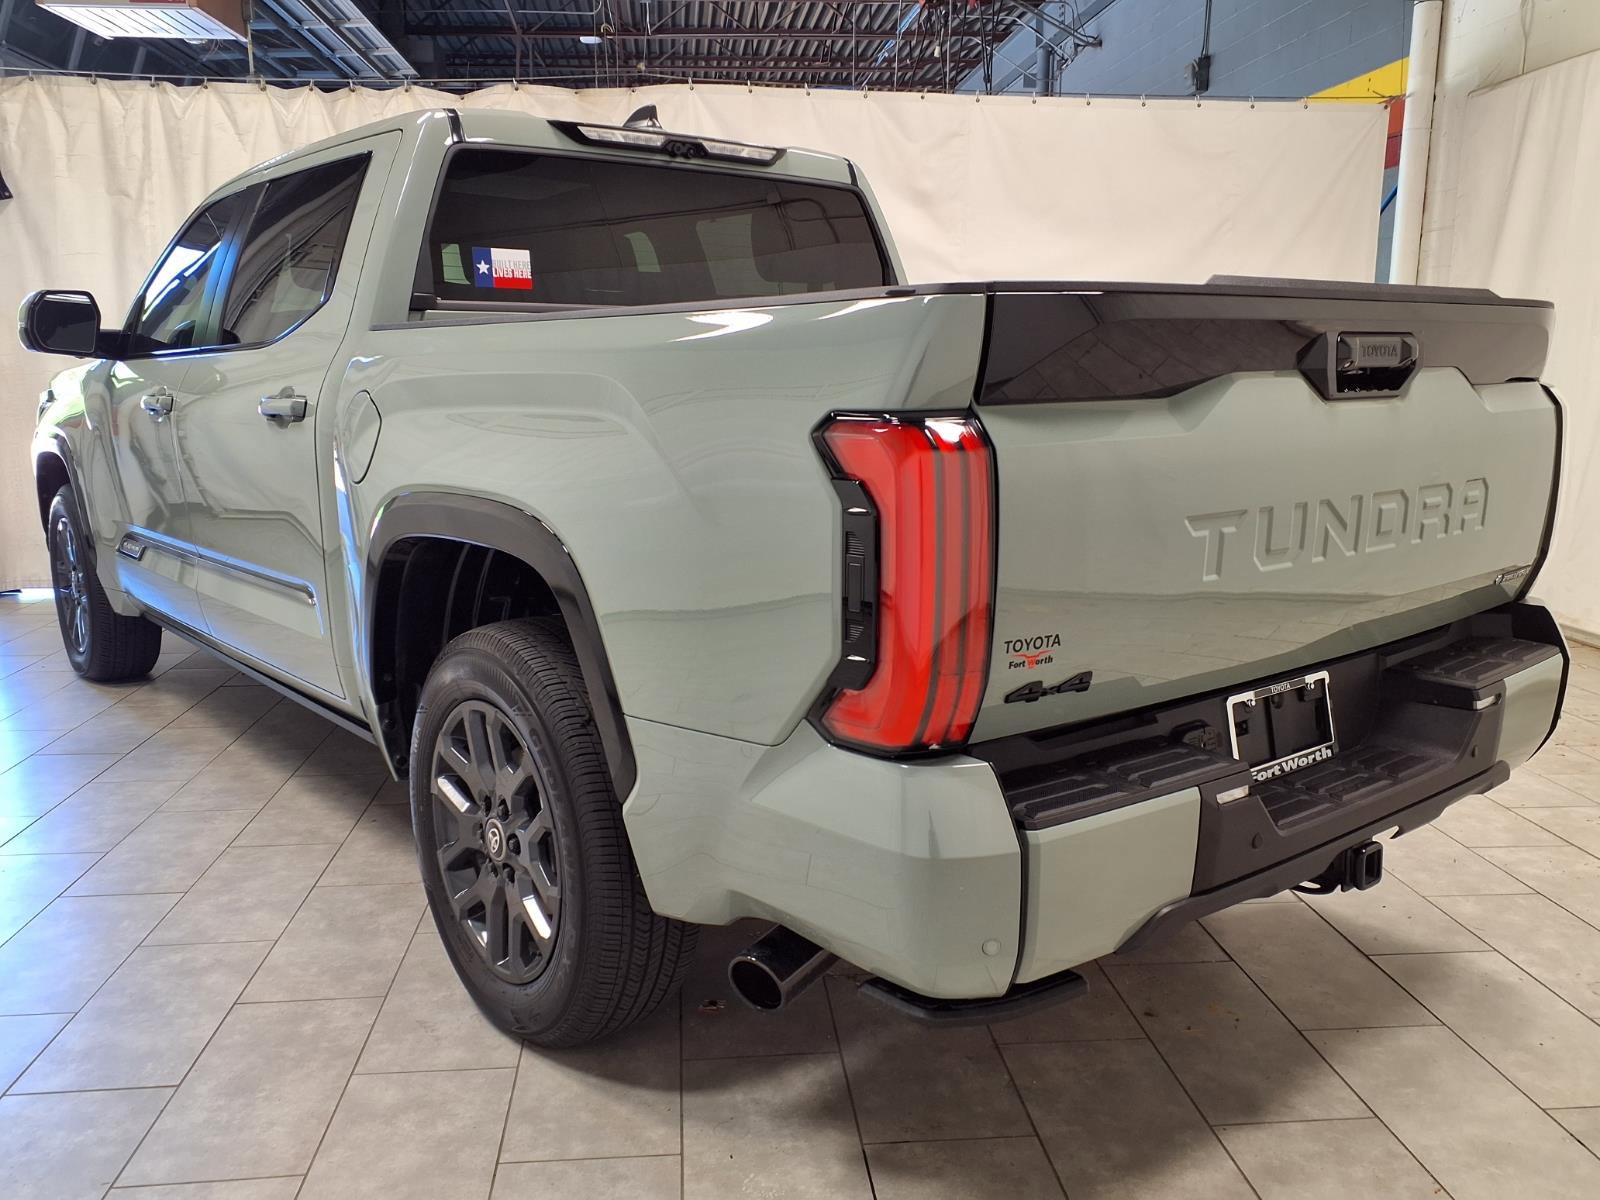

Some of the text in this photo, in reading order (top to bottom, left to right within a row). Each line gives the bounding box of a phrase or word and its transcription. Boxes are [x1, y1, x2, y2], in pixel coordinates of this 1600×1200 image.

[492, 267, 532, 279] LIVES HERE
[1361, 343, 1398, 358] TOYOTA
[1184, 477, 1490, 582] TUNDRA
[1004, 634, 1061, 654] TOYOTA
[1008, 660, 1026, 669] Fort
[1271, 683, 1291, 694] TOYOTA
[1281, 747, 1332, 772] Worth
